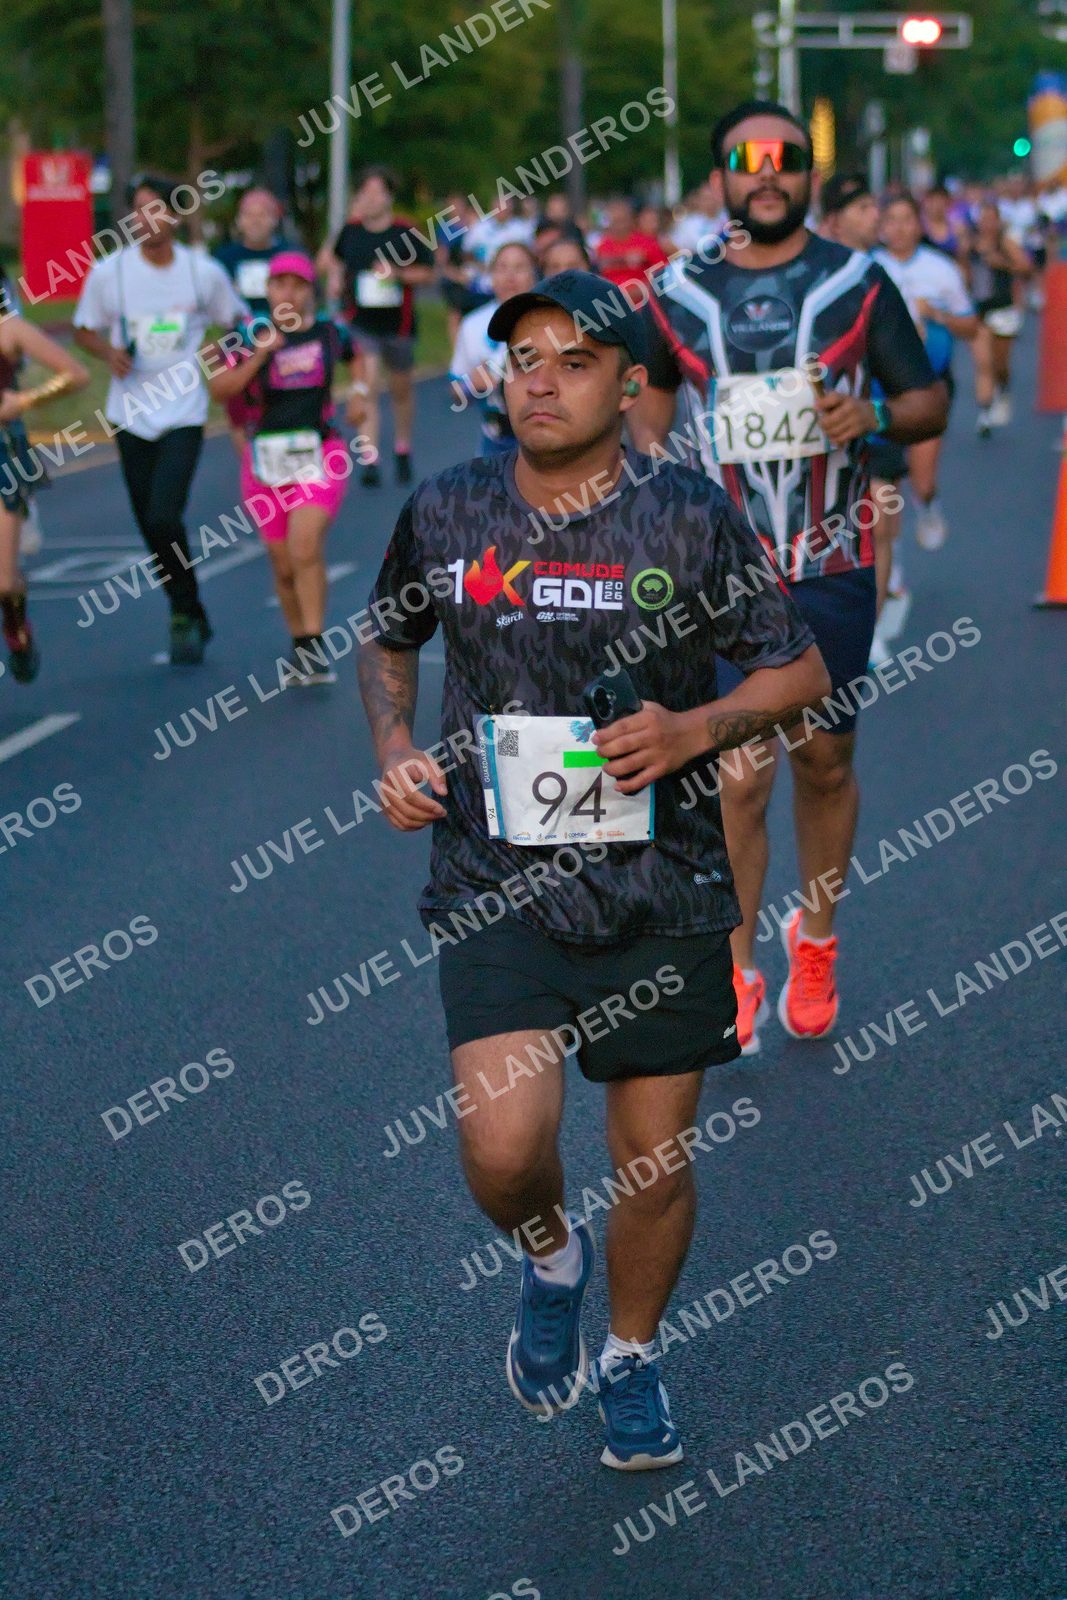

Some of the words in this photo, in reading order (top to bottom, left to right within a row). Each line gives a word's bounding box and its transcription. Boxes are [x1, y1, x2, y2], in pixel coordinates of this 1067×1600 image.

[721, 408, 821, 450] 1842
[534, 561, 624, 579] COMUDE
[532, 577, 623, 610] GDL
[605, 582, 623, 590] 20
[605, 591, 623, 600] 26
[532, 771, 607, 826] 94
[487, 808, 496, 819] 94
